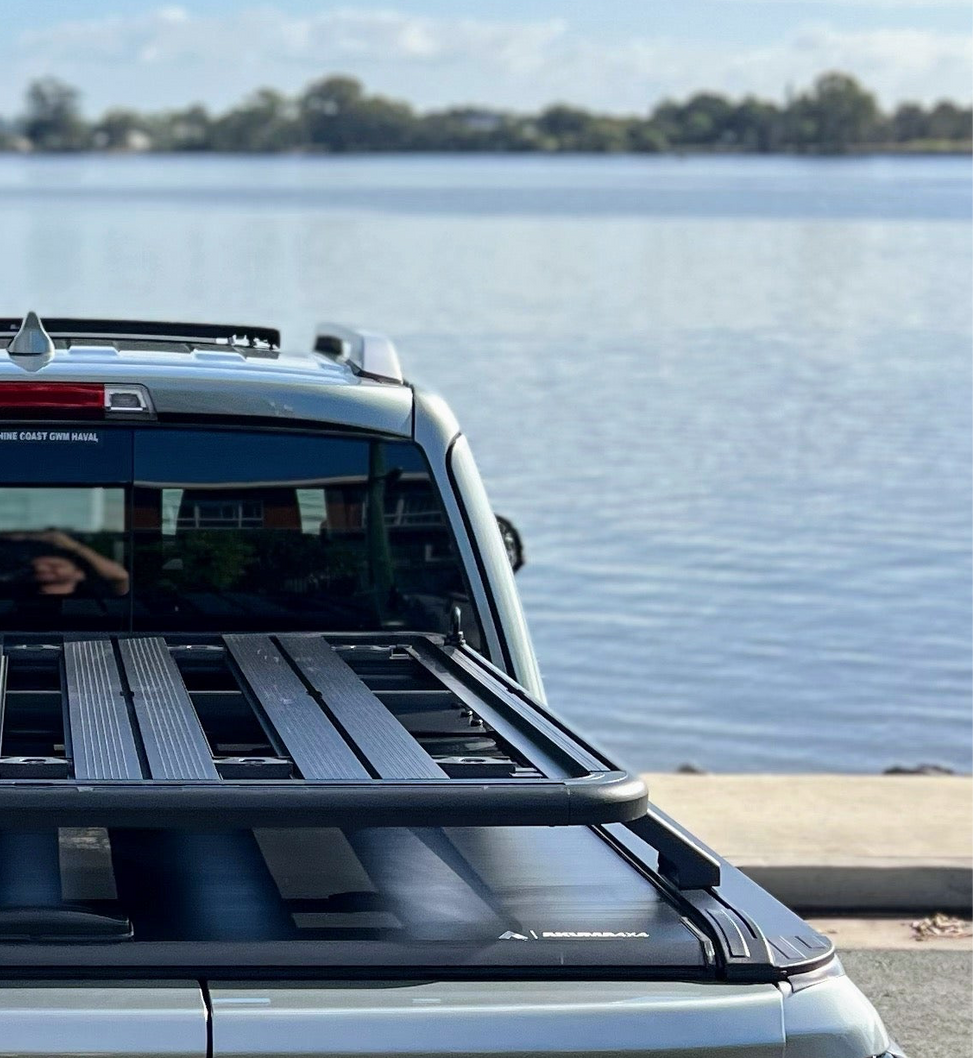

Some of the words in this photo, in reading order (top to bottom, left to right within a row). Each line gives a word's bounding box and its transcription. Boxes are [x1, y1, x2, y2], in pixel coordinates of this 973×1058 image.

[19, 431, 48, 441] COAST
[49, 432, 70, 441] GWM
[71, 432, 99, 443] HAVAL
